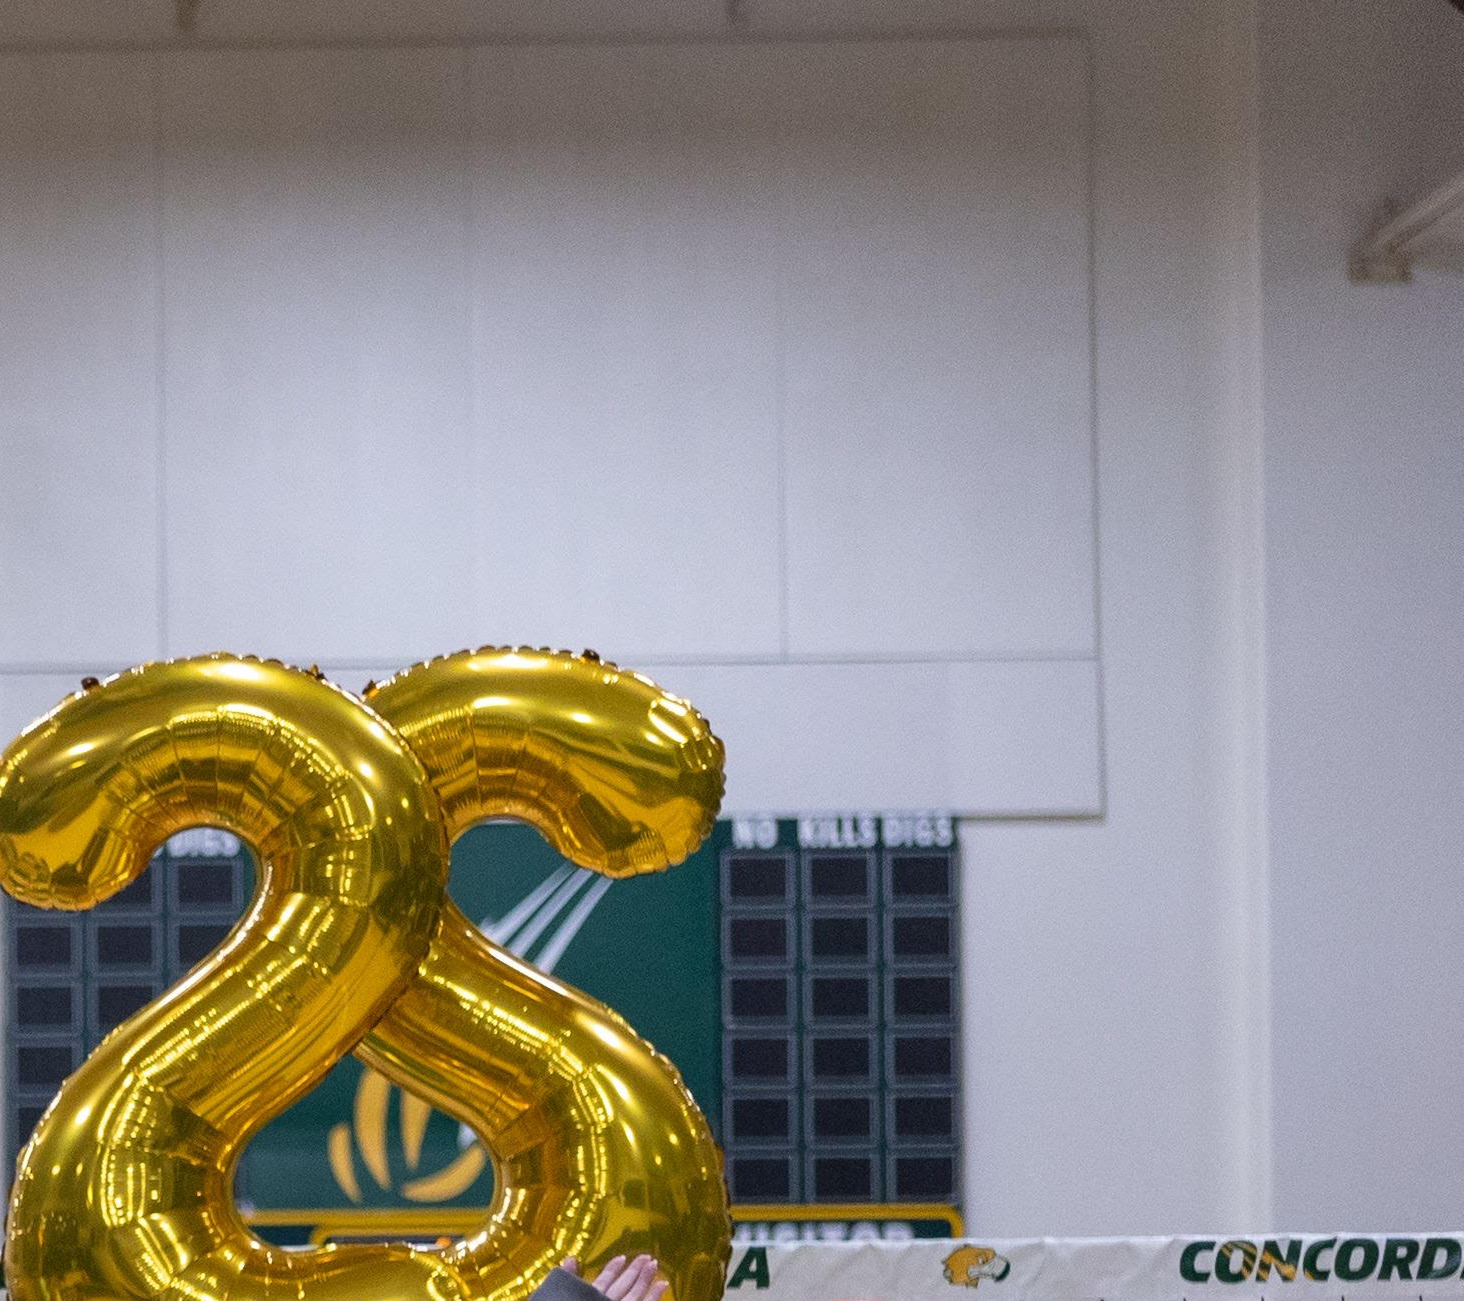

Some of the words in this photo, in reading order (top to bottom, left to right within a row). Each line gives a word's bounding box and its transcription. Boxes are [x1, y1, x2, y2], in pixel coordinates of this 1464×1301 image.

[731, 812, 778, 849] NO
[797, 808, 877, 849] KILLS
[882, 808, 953, 847] DIGS
[1179, 1238, 1464, 1284] CONCORD
